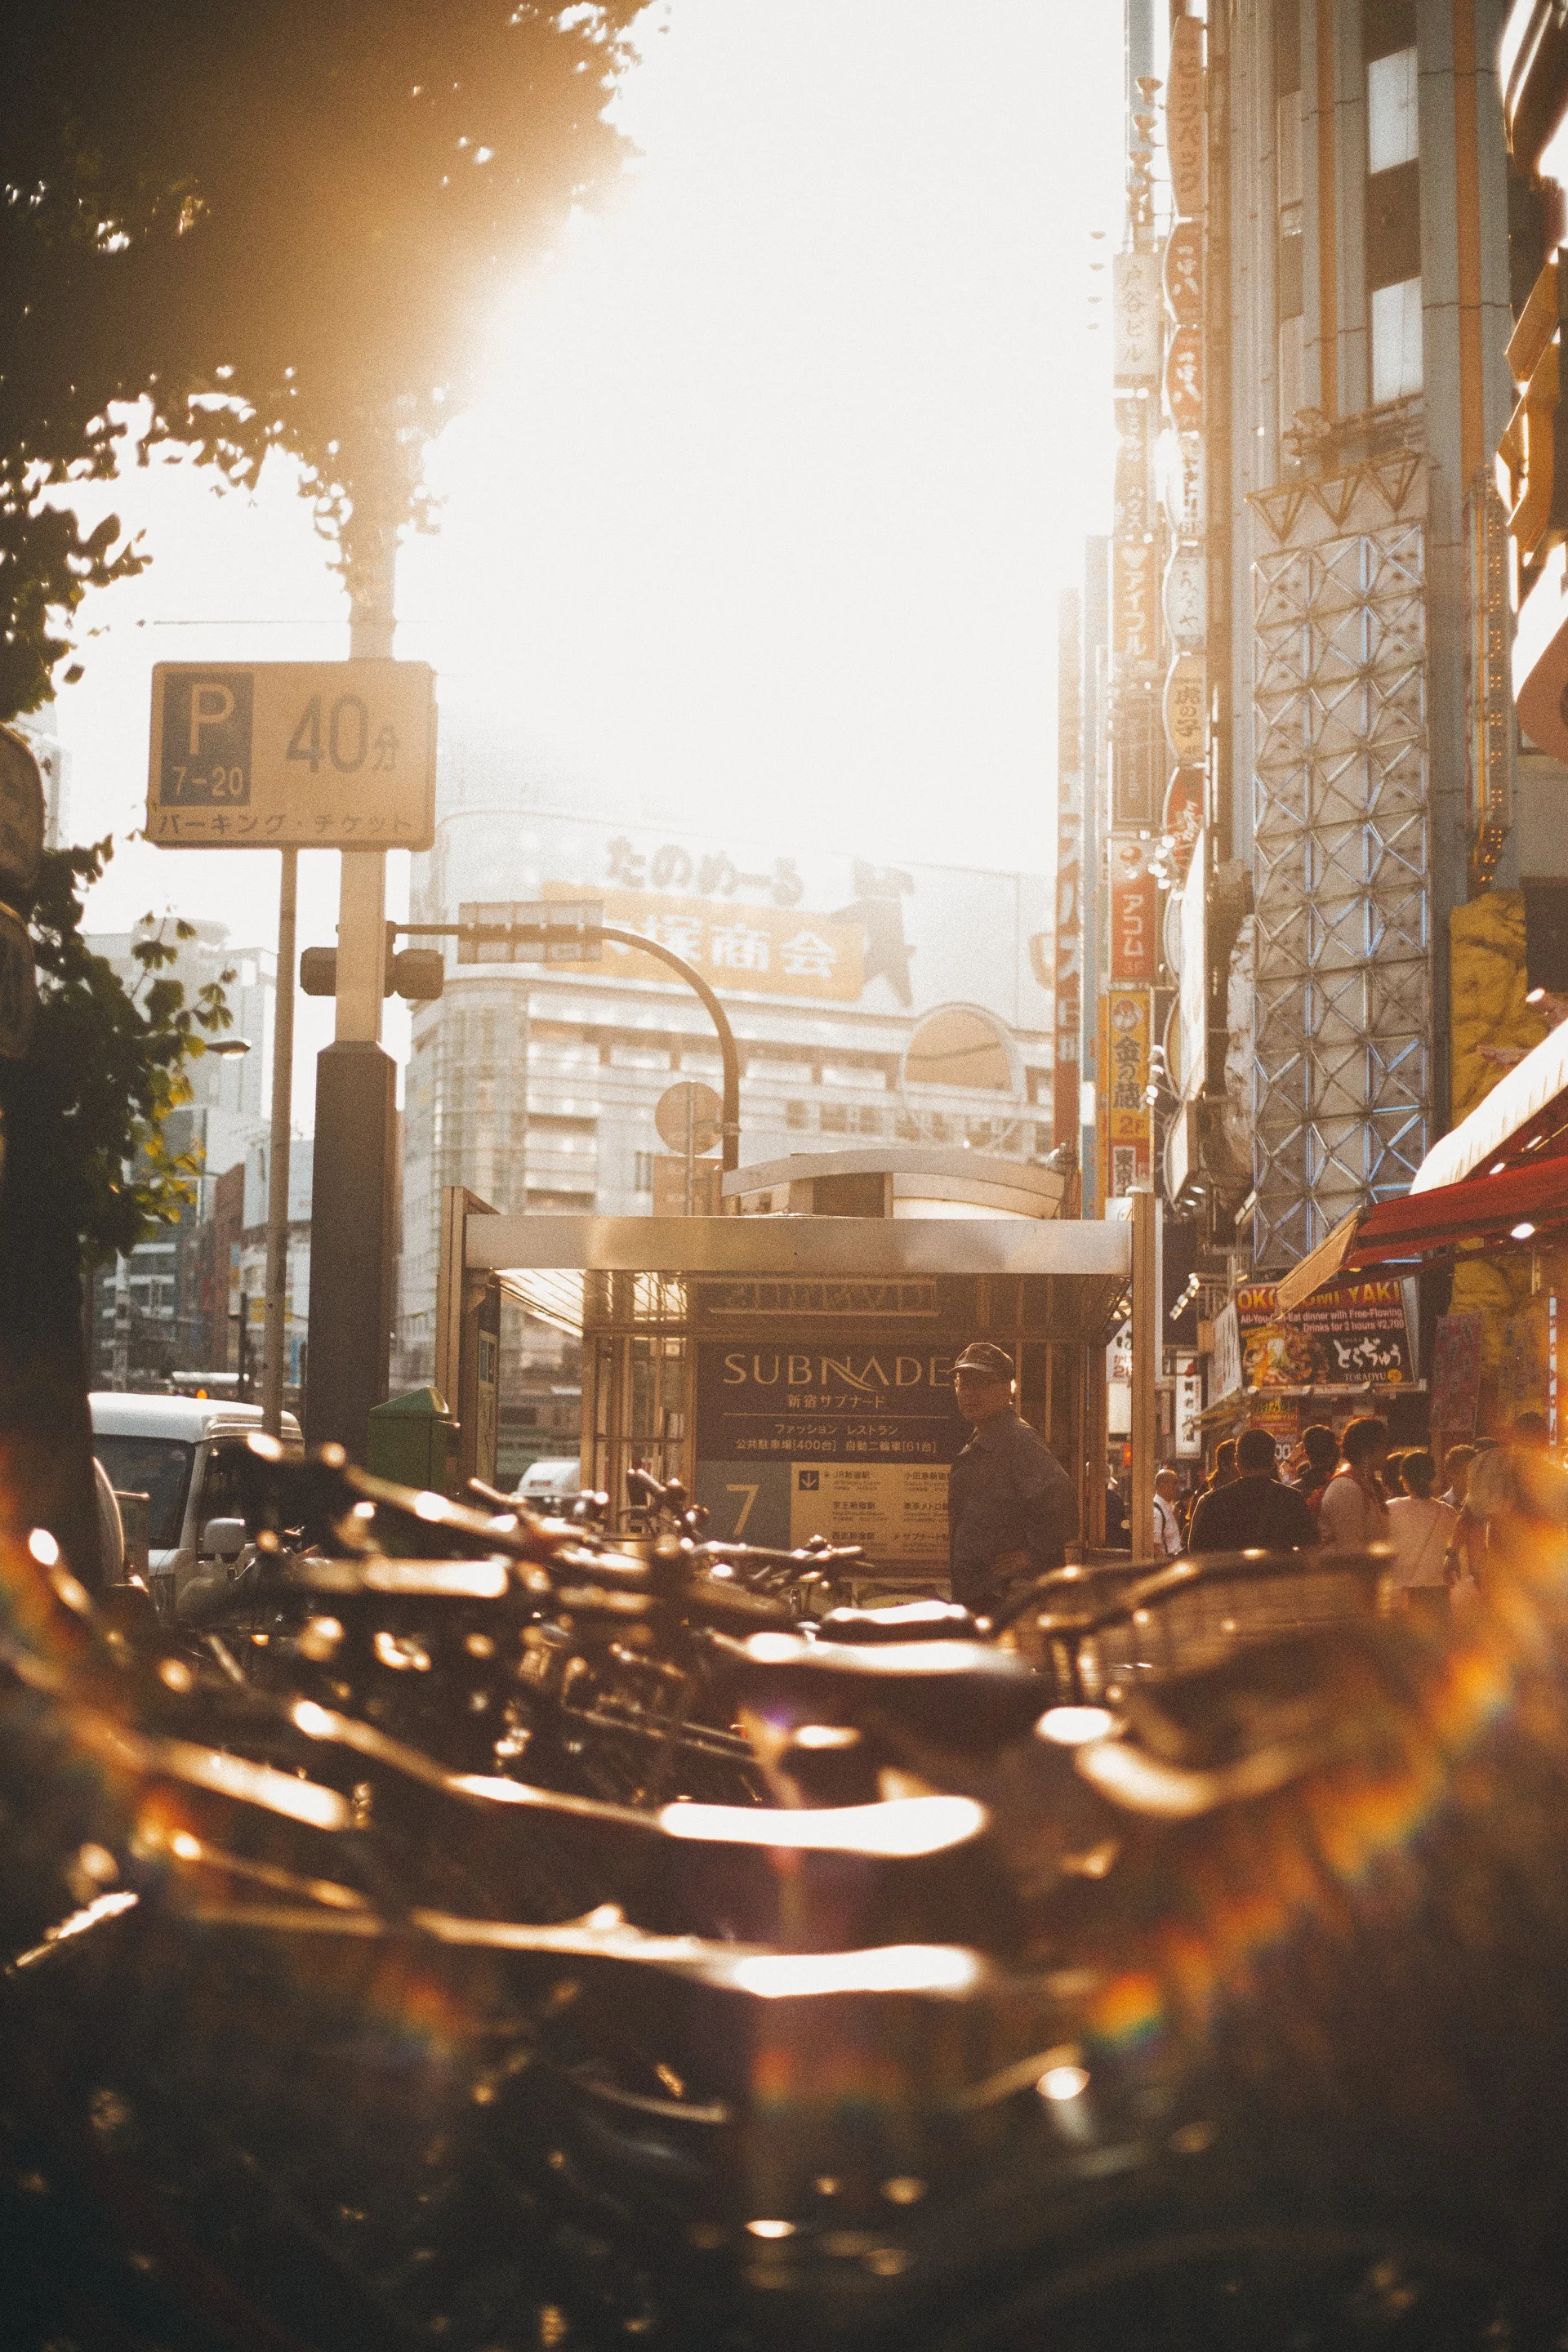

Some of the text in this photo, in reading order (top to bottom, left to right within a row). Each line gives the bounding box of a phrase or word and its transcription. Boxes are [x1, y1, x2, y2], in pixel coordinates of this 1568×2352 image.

[1123, 570, 1147, 656] アイフル
[189, 683, 234, 756] P
[172, 765, 244, 797] 7-20
[159, 814, 412, 835] パーキング・チケット
[605, 835, 804, 906] たのめーる
[1348, 1281, 1401, 1304] YAKI
[1241, 1311, 1302, 1324] All-You-Cn-Eat
[1303, 1312, 1329, 1321] dinner
[1330, 1311, 1348, 1320] with
[1303, 1323, 1330, 1332] Drinks
[1330, 1322, 1343, 1332] for
[1351, 1321, 1376, 1330] hours
[723, 1353, 951, 1391] SUBNADE
[786, 1393, 885, 1409] 新宿サブナード
[775, 1423, 899, 1436] ファッション レストラン
[904, 1472, 949, 1480] 小田急新宿
[725, 1483, 760, 1535] 7
